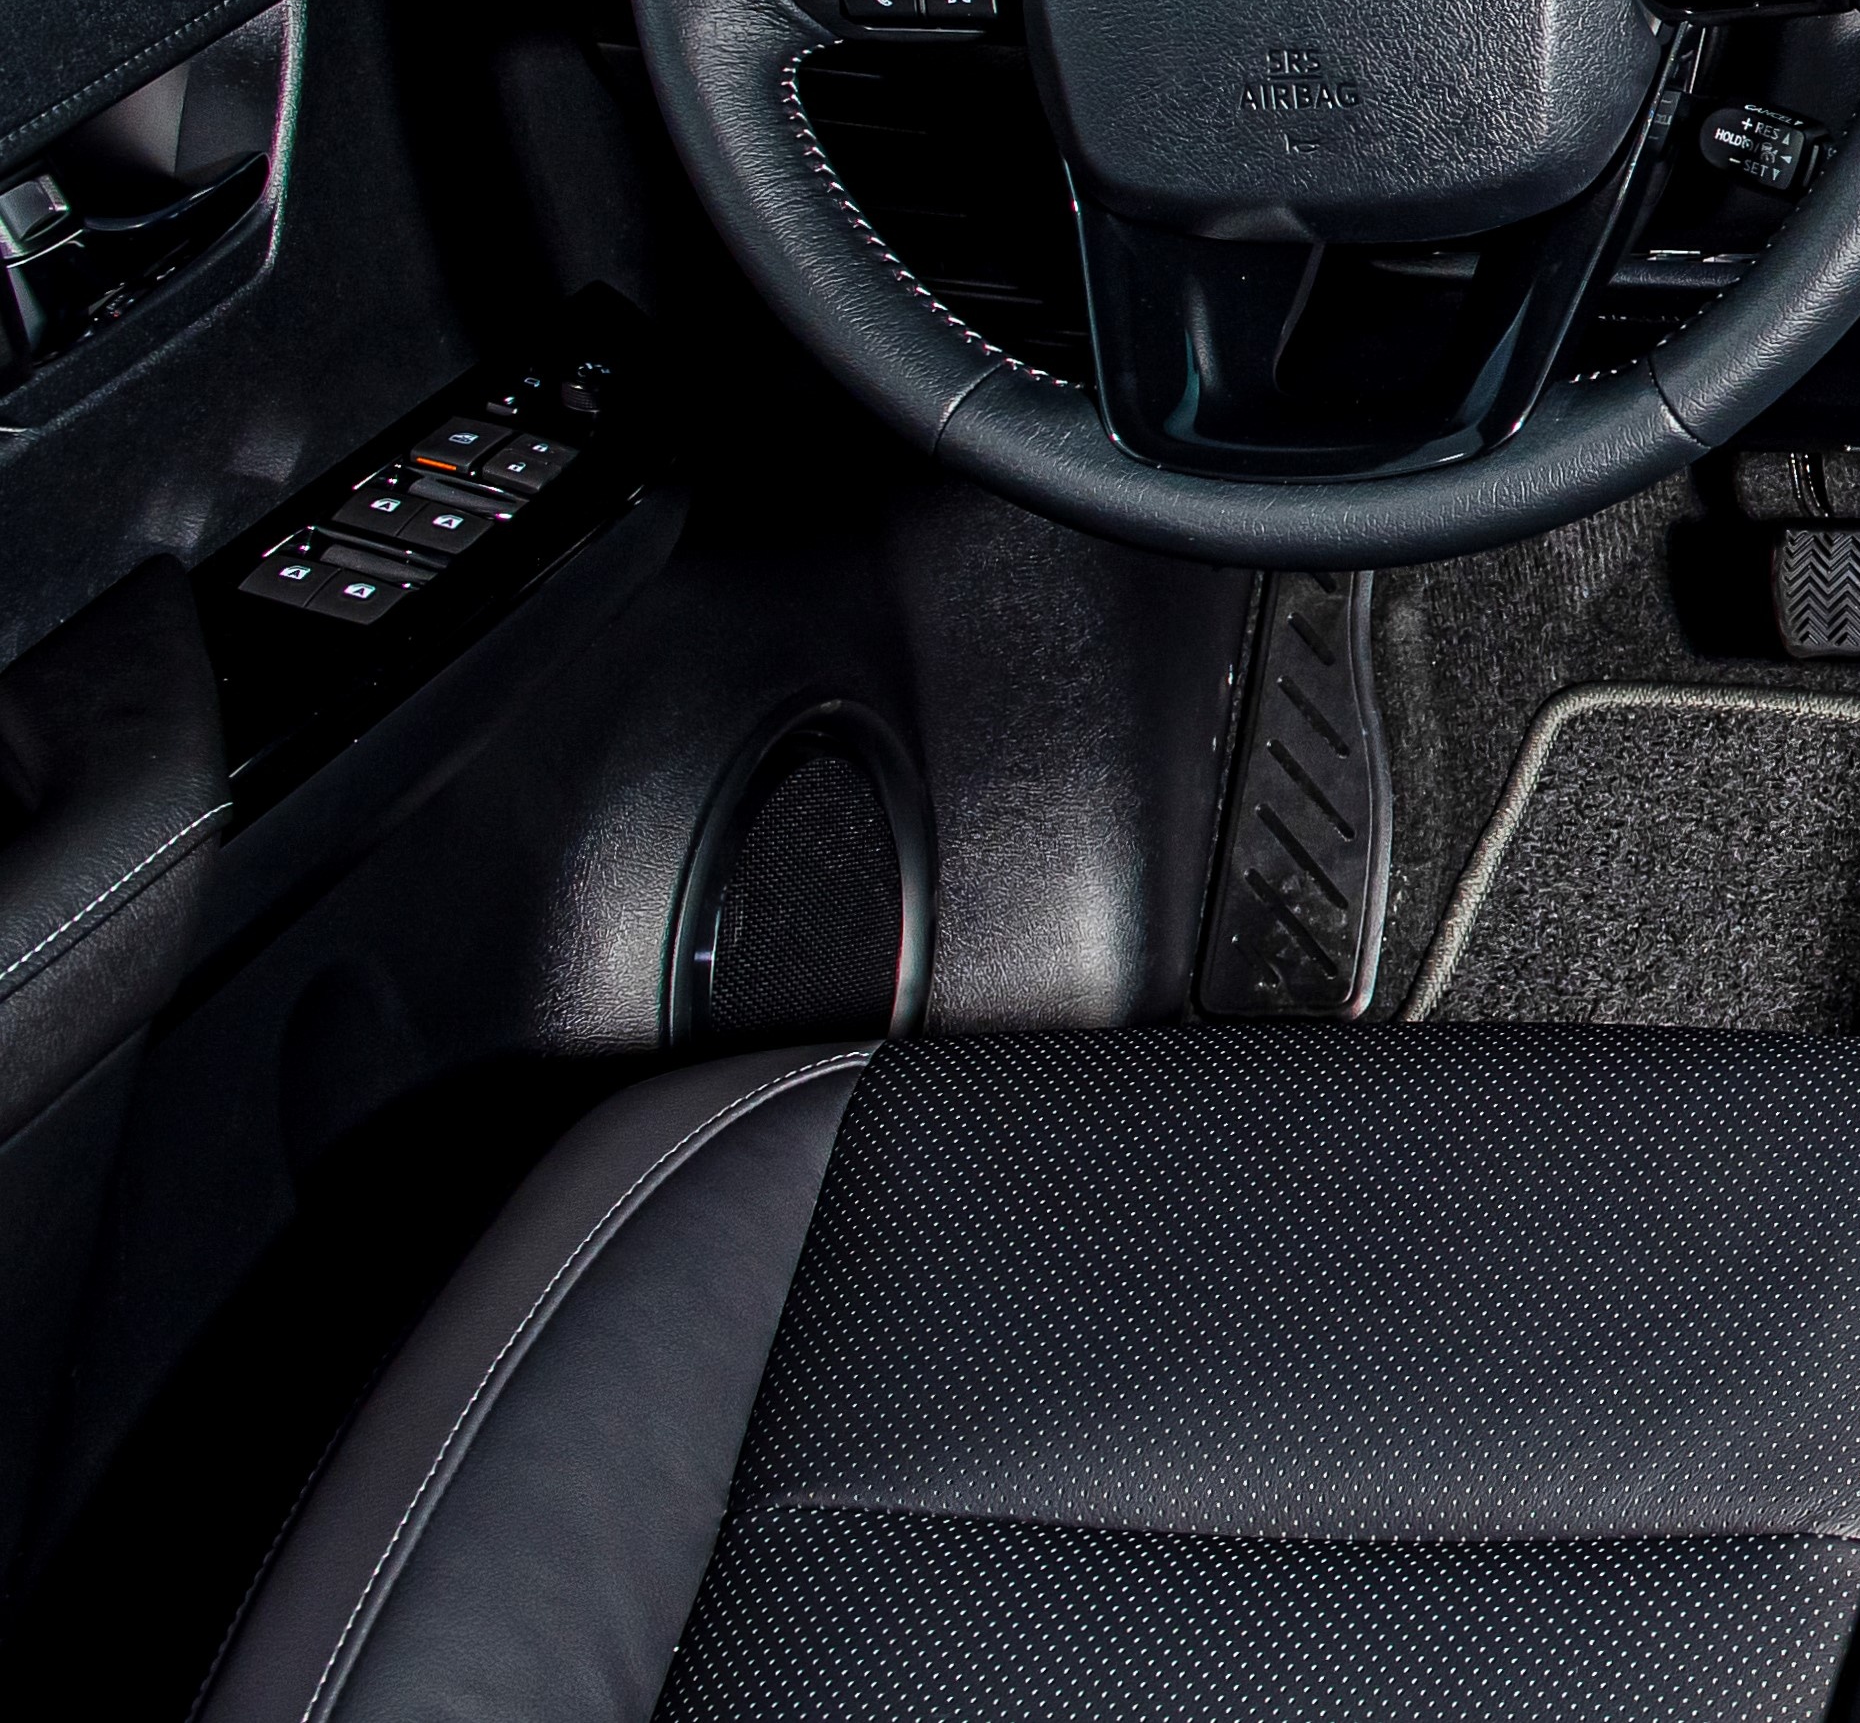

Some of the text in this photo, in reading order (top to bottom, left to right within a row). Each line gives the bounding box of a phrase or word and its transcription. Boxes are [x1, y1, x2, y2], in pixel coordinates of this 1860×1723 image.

[1266, 49, 1321, 74] SRS
[1237, 82, 1361, 110] AIRBAG
[1744, 104, 1792, 124] CANCEL
[1715, 128, 1743, 146] HOLD
